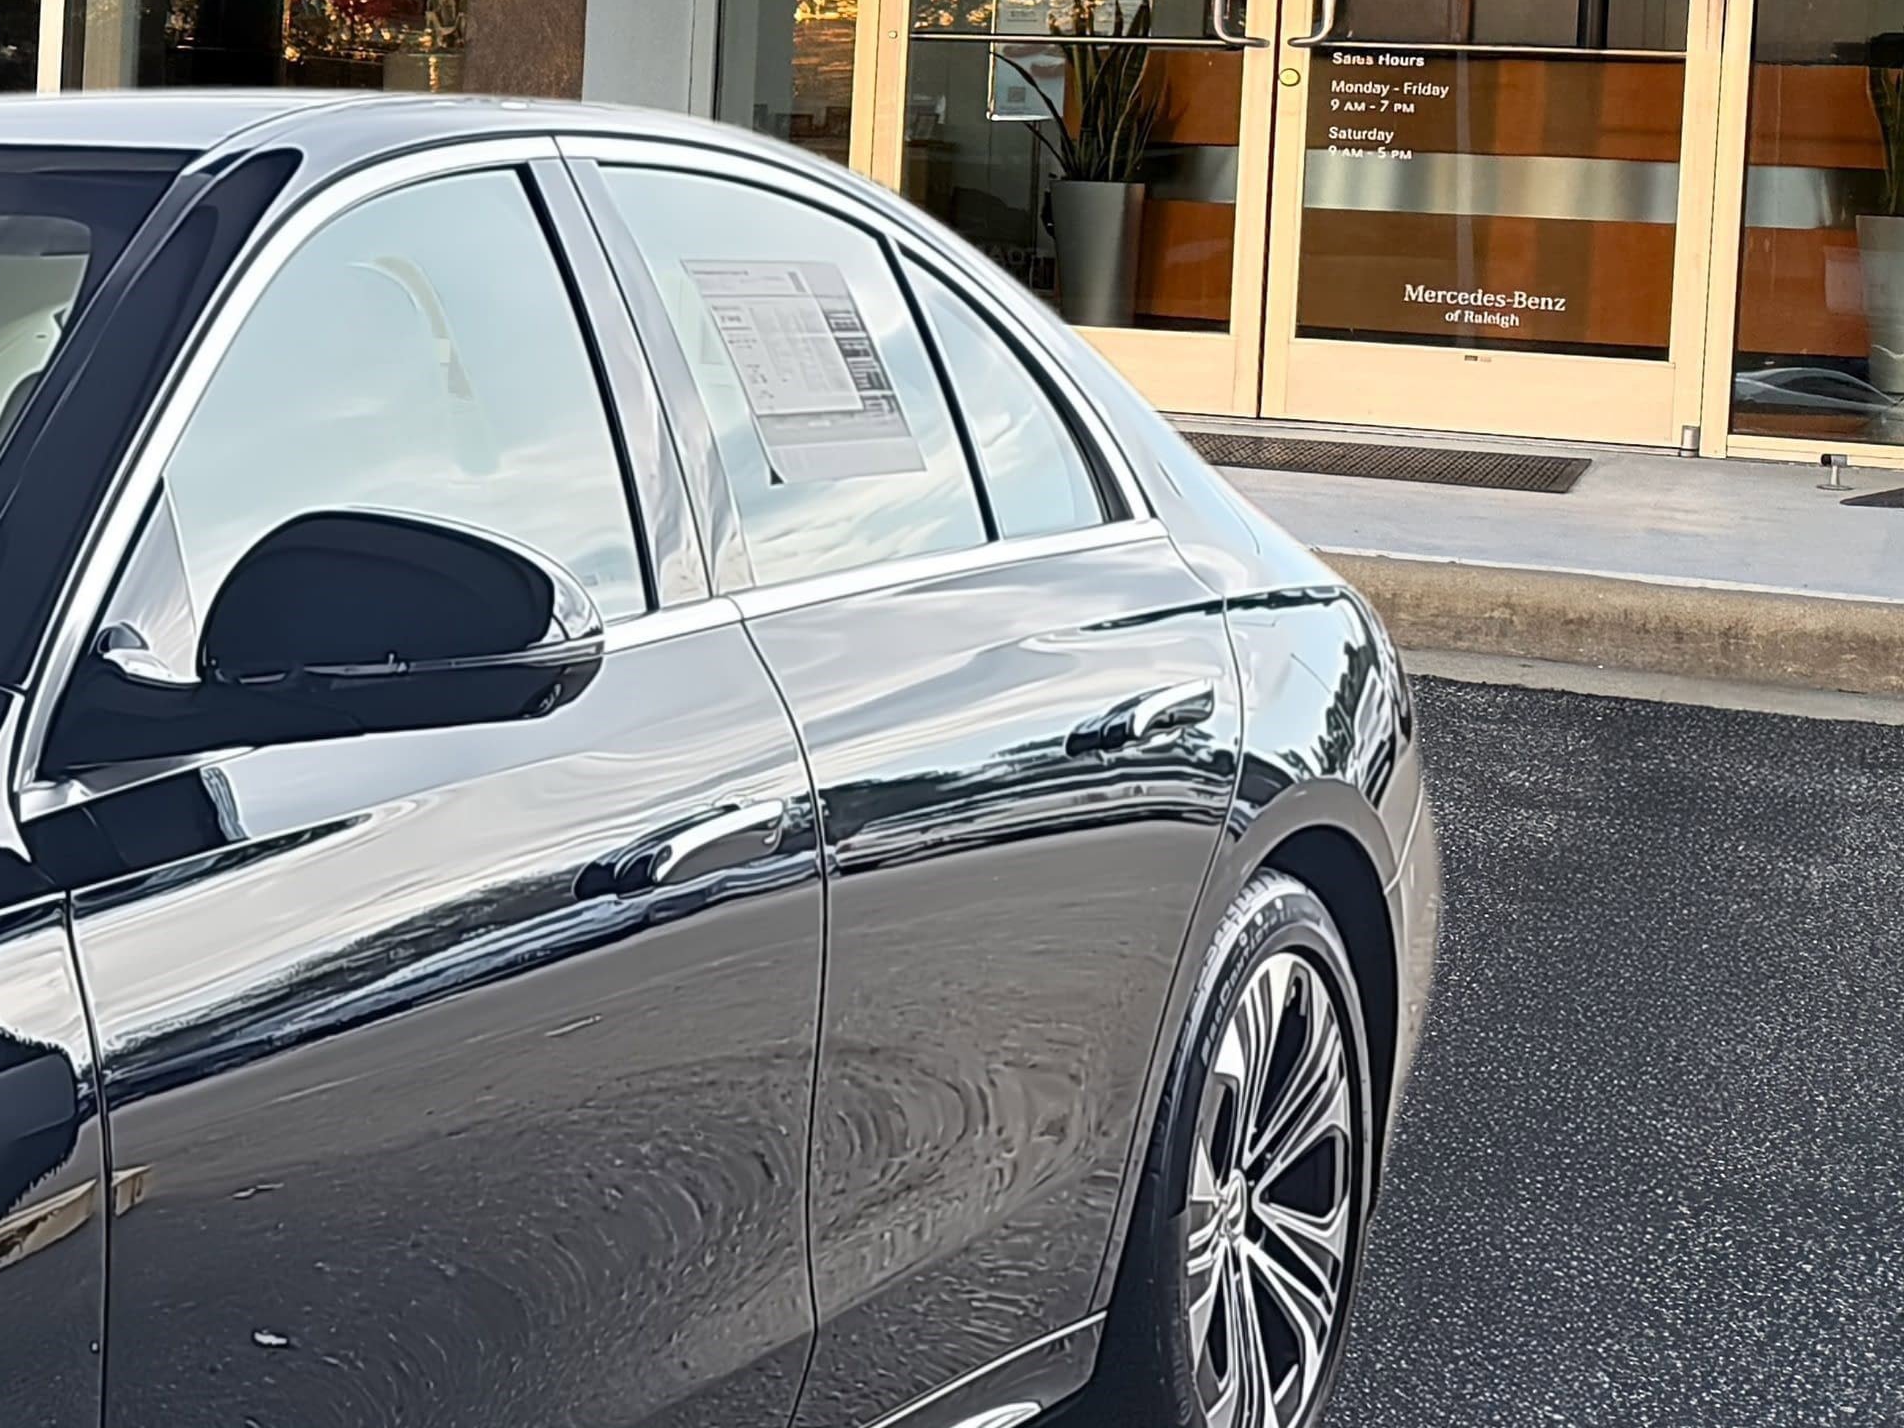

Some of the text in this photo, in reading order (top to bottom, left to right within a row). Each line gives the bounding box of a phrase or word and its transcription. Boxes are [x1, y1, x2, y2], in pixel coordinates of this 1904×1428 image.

[1378, 53, 1425, 67] Hours
[1331, 79, 1390, 98] Monday
[1403, 82, 1449, 99] Friday
[1330, 99, 1340, 112] 9
[1343, 101, 1367, 112] AM
[1380, 100, 1389, 113] 7
[1393, 103, 1415, 114] PM
[1328, 126, 1394, 145] Saturday
[1328, 145, 1337, 157] 9
[1342, 148, 1364, 159] AM
[1377, 147, 1387, 159] 5
[1391, 150, 1413, 161] PM
[1403, 283, 1567, 312] Mercedes-Benz
[1445, 310, 1520, 329] of Raleigh
